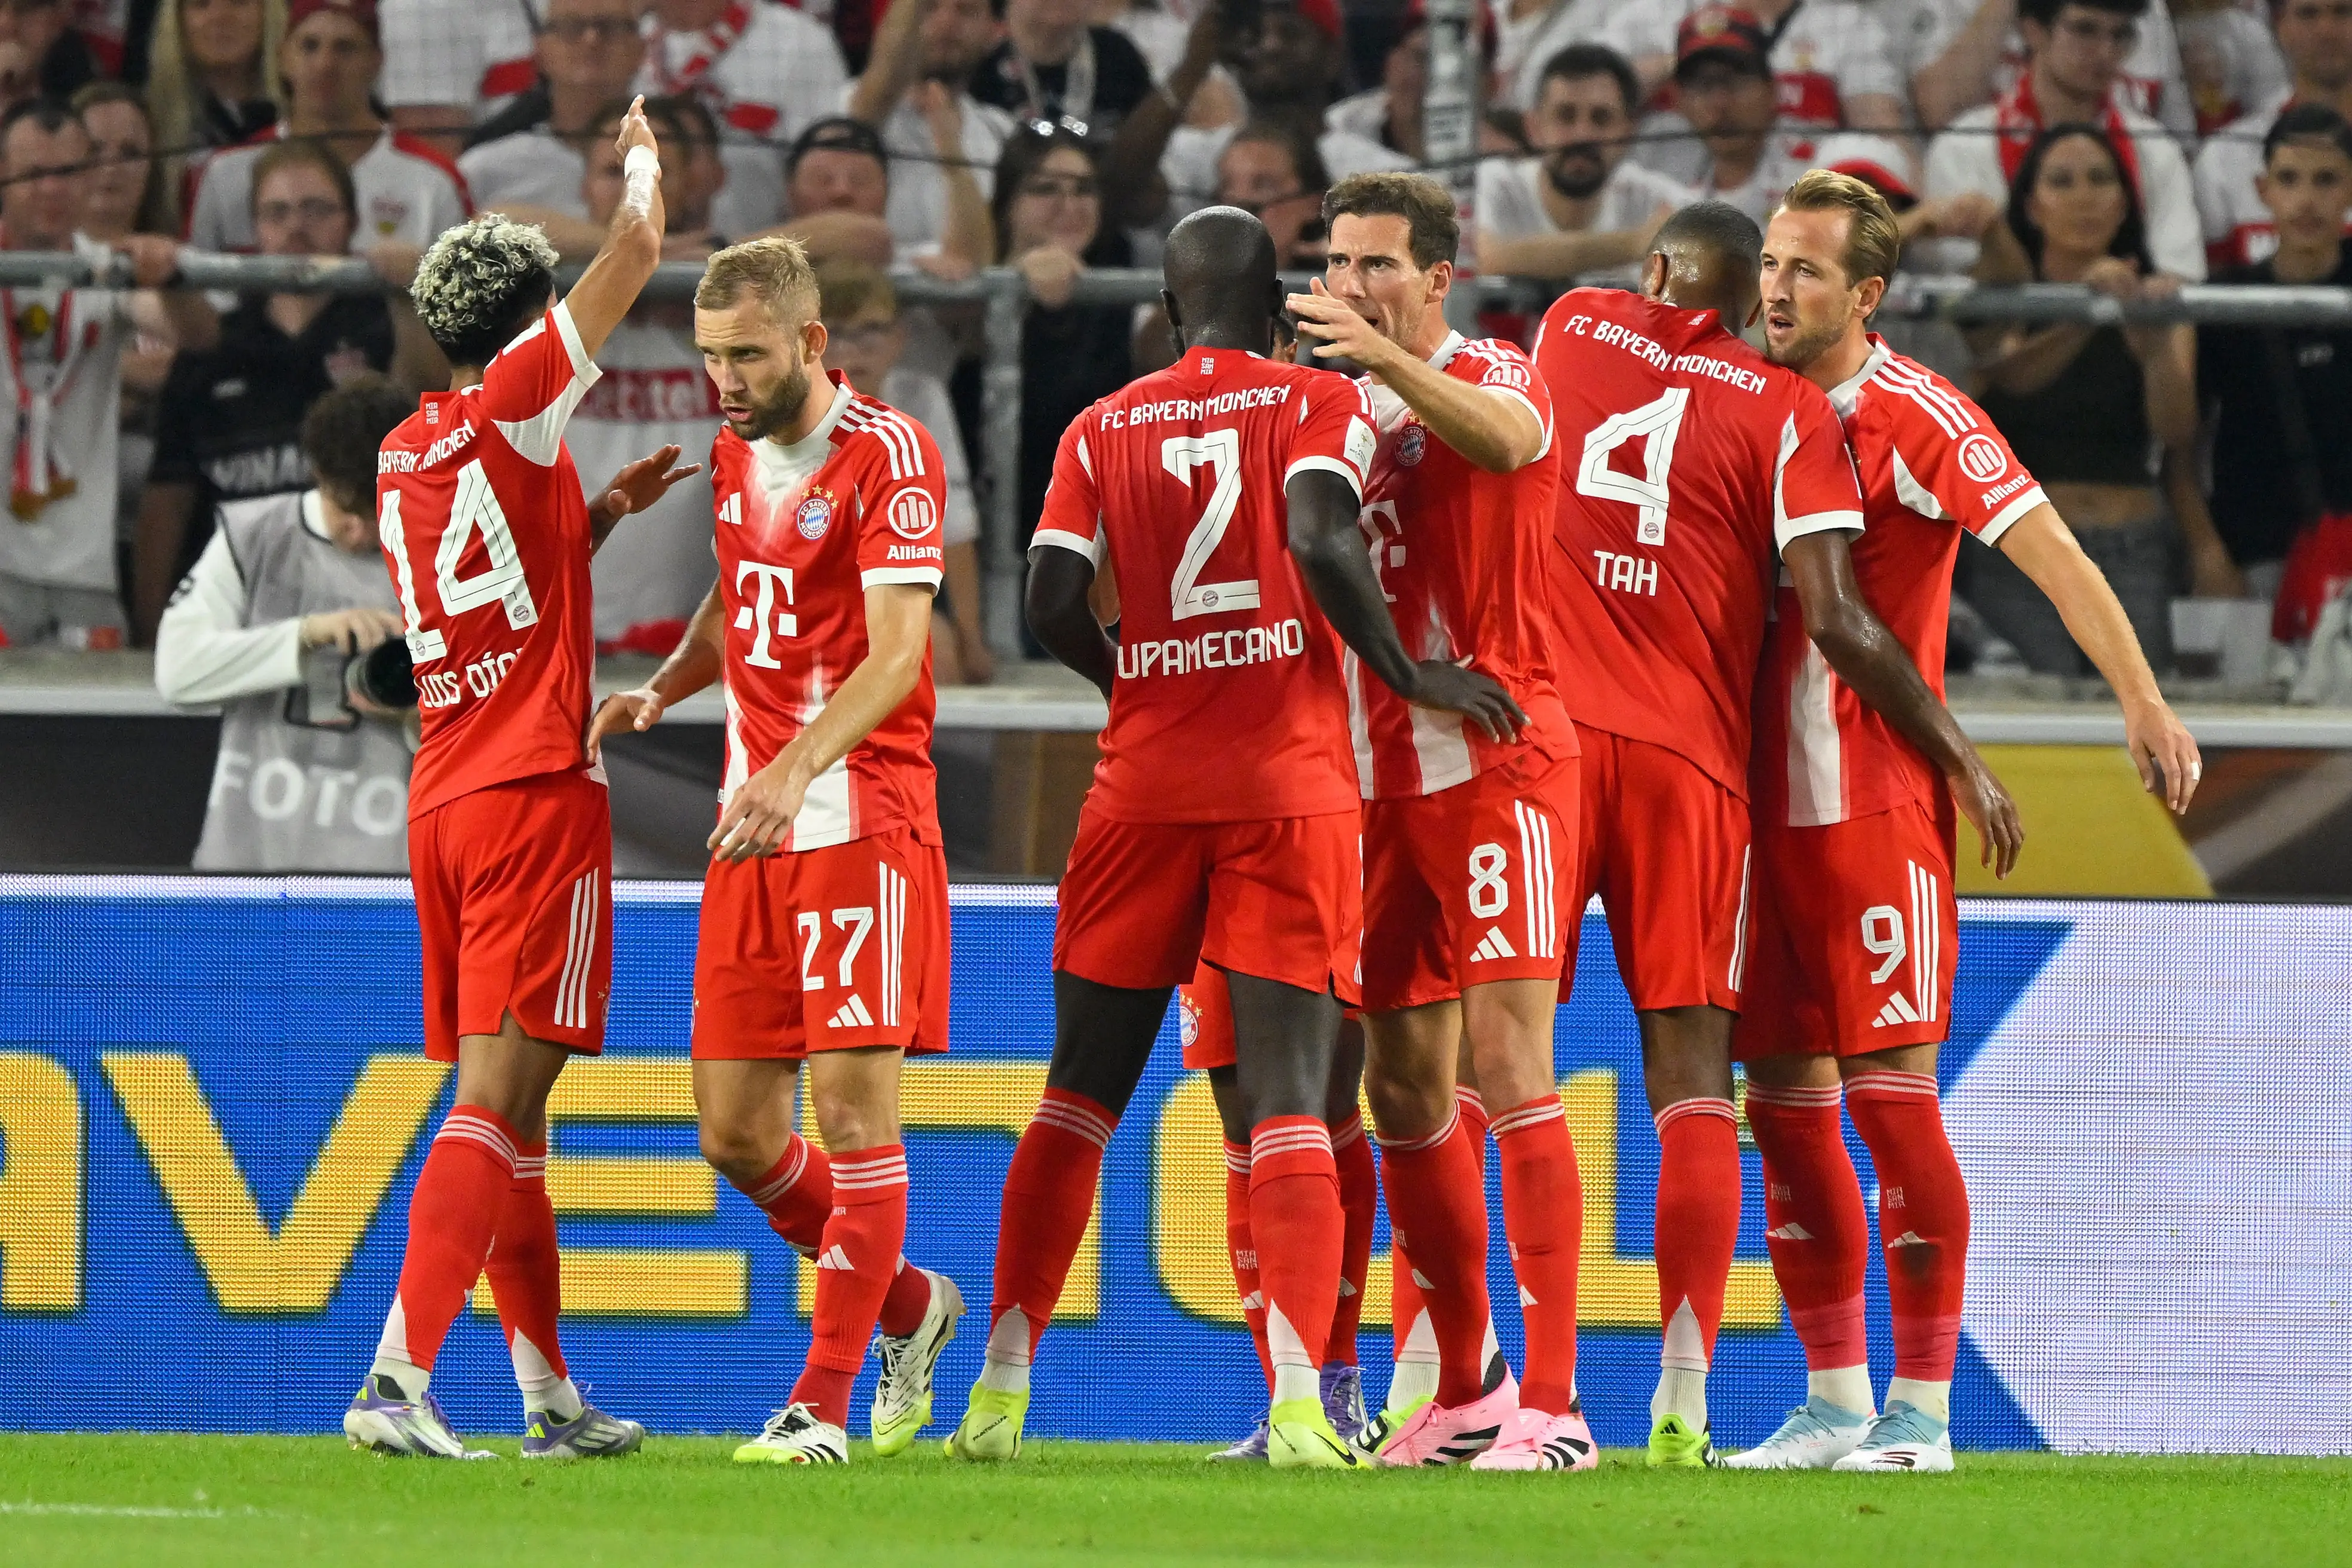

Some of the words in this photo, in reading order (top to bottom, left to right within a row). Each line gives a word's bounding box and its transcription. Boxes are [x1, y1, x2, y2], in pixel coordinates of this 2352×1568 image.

[1563, 314, 1592, 335] FC
[1592, 320, 1672, 372] BAYERN
[1673, 354, 1766, 394] MÜNCHEN
[1101, 411, 1125, 431] FC
[1129, 399, 1204, 425] BAYERN
[1206, 385, 1291, 416] MÜNCHEN
[378, 451, 421, 474] BAYERN
[1576, 387, 1690, 546] 4
[1981, 474, 2031, 510] Allianz
[808, 501, 829, 517] BAYERN
[1161, 428, 1261, 621] 2
[379, 458, 538, 664] 14
[886, 545, 942, 561] Allianz
[1594, 550, 1658, 596] TAH
[414, 670, 461, 708] LUIS
[466, 647, 523, 698] DÍ
[1117, 618, 1304, 679] UPAMECANO
[210, 749, 409, 837] FOTO
[1468, 843, 1509, 919] 8
[797, 906, 874, 991] 27
[1861, 905, 1907, 985] 9
